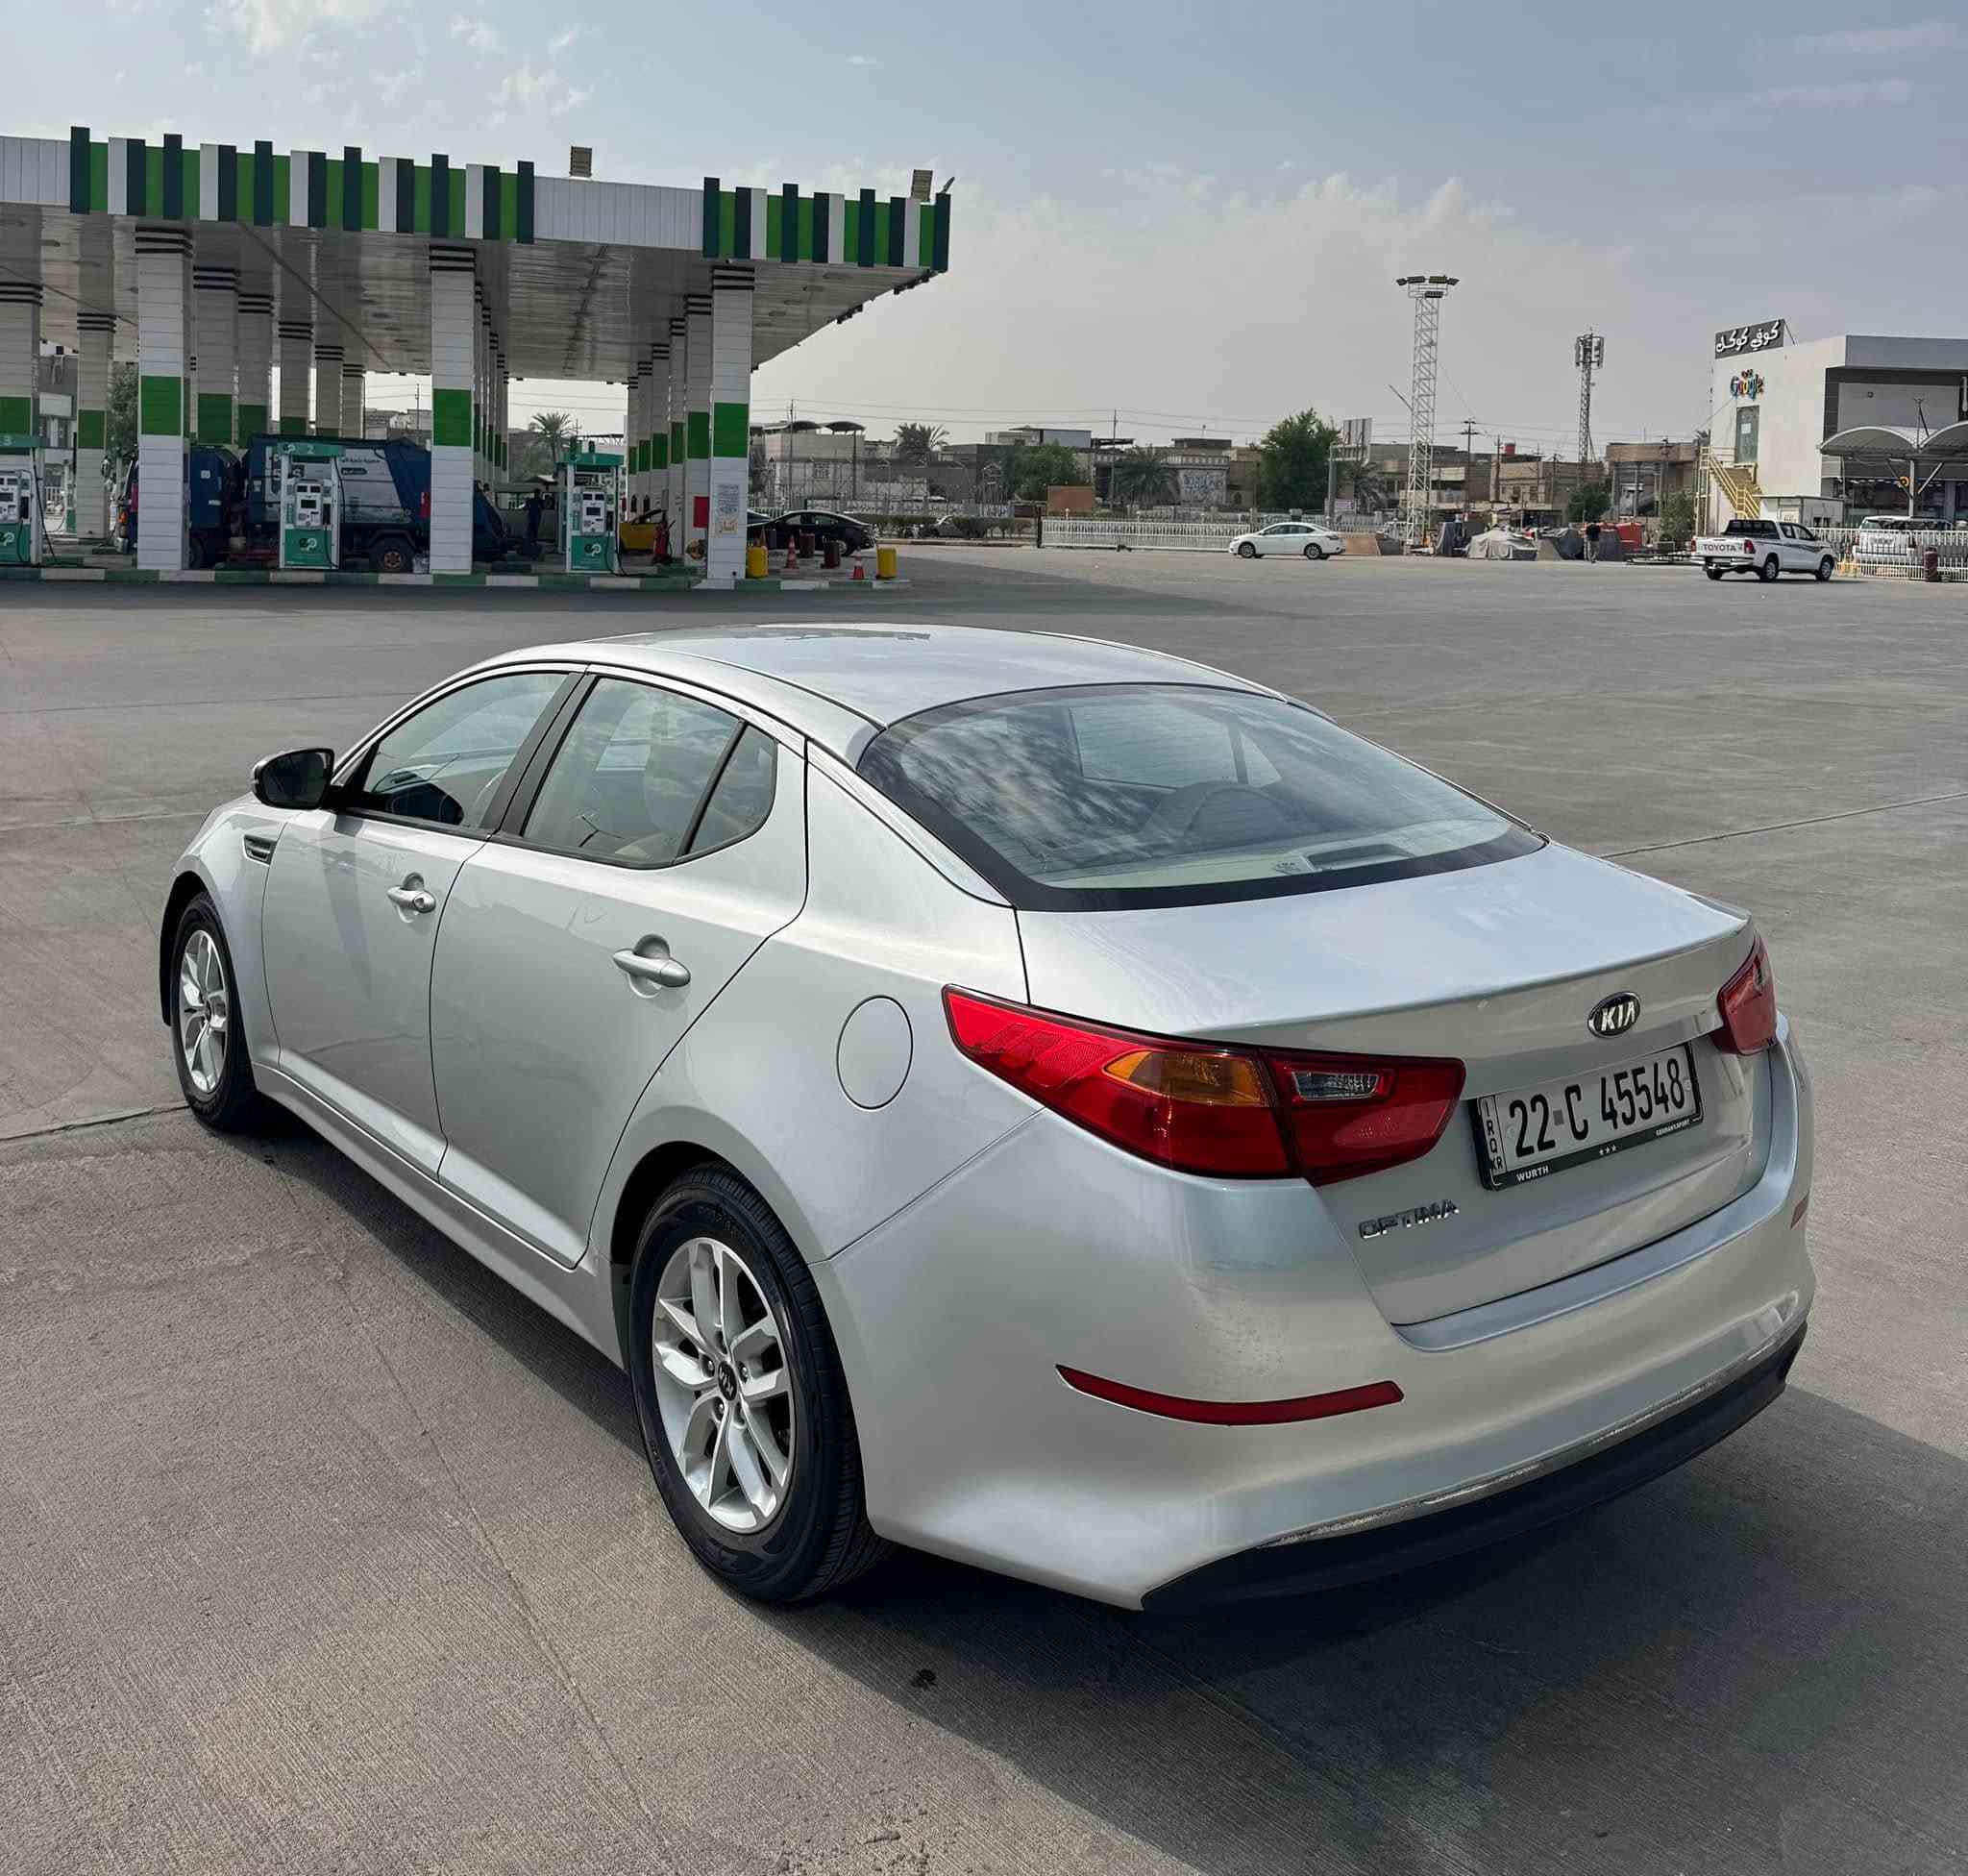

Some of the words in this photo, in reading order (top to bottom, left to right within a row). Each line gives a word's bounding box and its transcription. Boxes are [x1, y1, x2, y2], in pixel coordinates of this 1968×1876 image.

[1750, 320, 1780, 351] كوفي
[1601, 1000, 1636, 1031] KIA
[1509, 1093, 1556, 1157] 22
[1564, 1084, 1589, 1141] C
[1600, 1058, 1685, 1129] 45548
[1516, 1165, 1549, 1182] WURTH
[1359, 1198, 1460, 1239] OPTIMA
